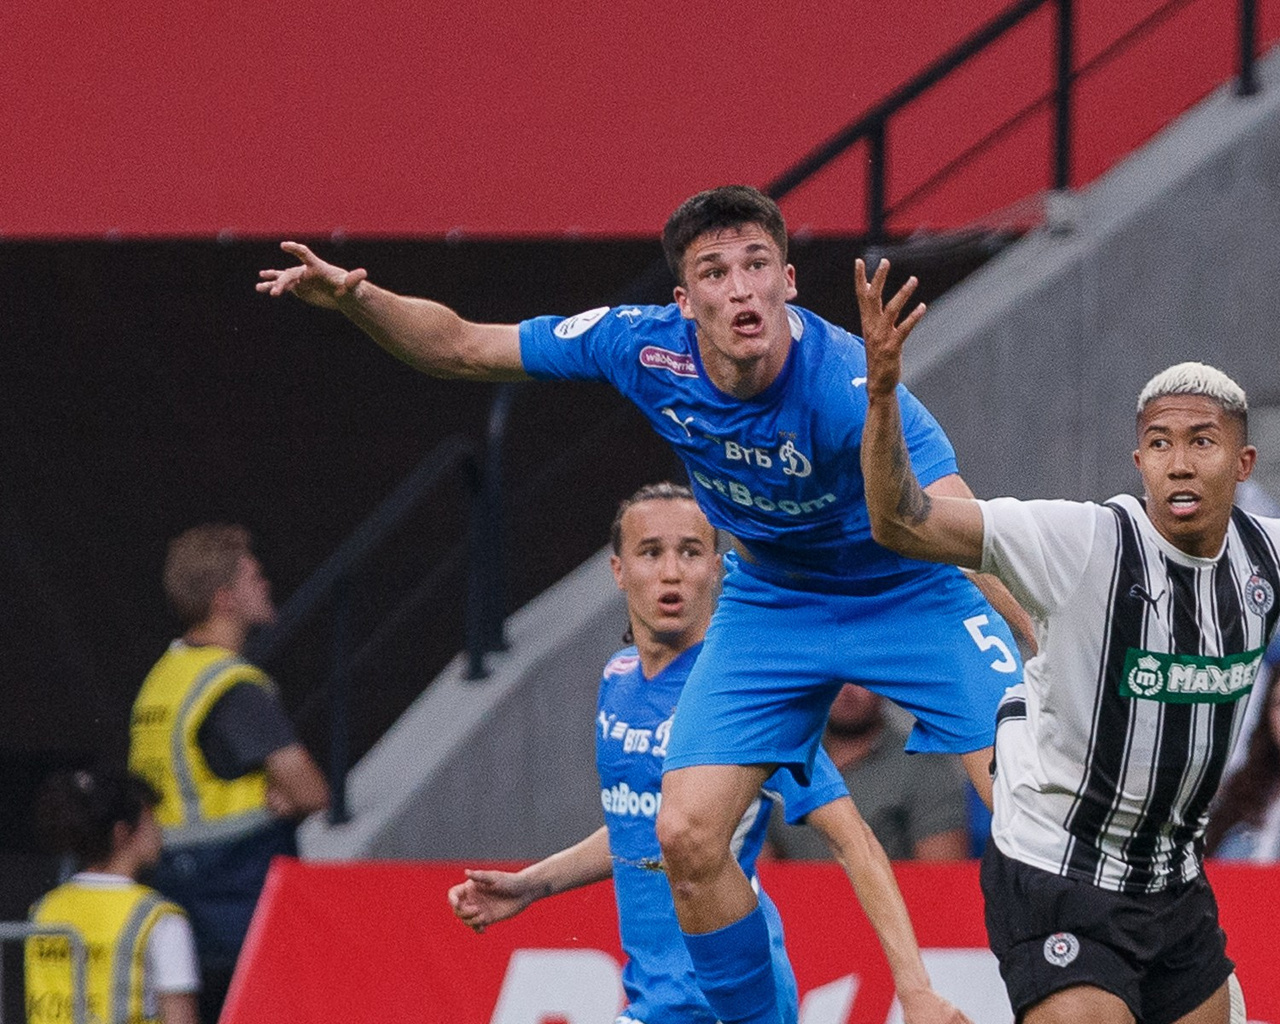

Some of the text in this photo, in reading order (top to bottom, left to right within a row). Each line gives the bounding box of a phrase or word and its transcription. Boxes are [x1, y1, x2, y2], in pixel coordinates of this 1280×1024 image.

[724, 440, 773, 468] ВТБ
[963, 614, 1017, 673] 5
[601, 781, 663, 817] etBoo
